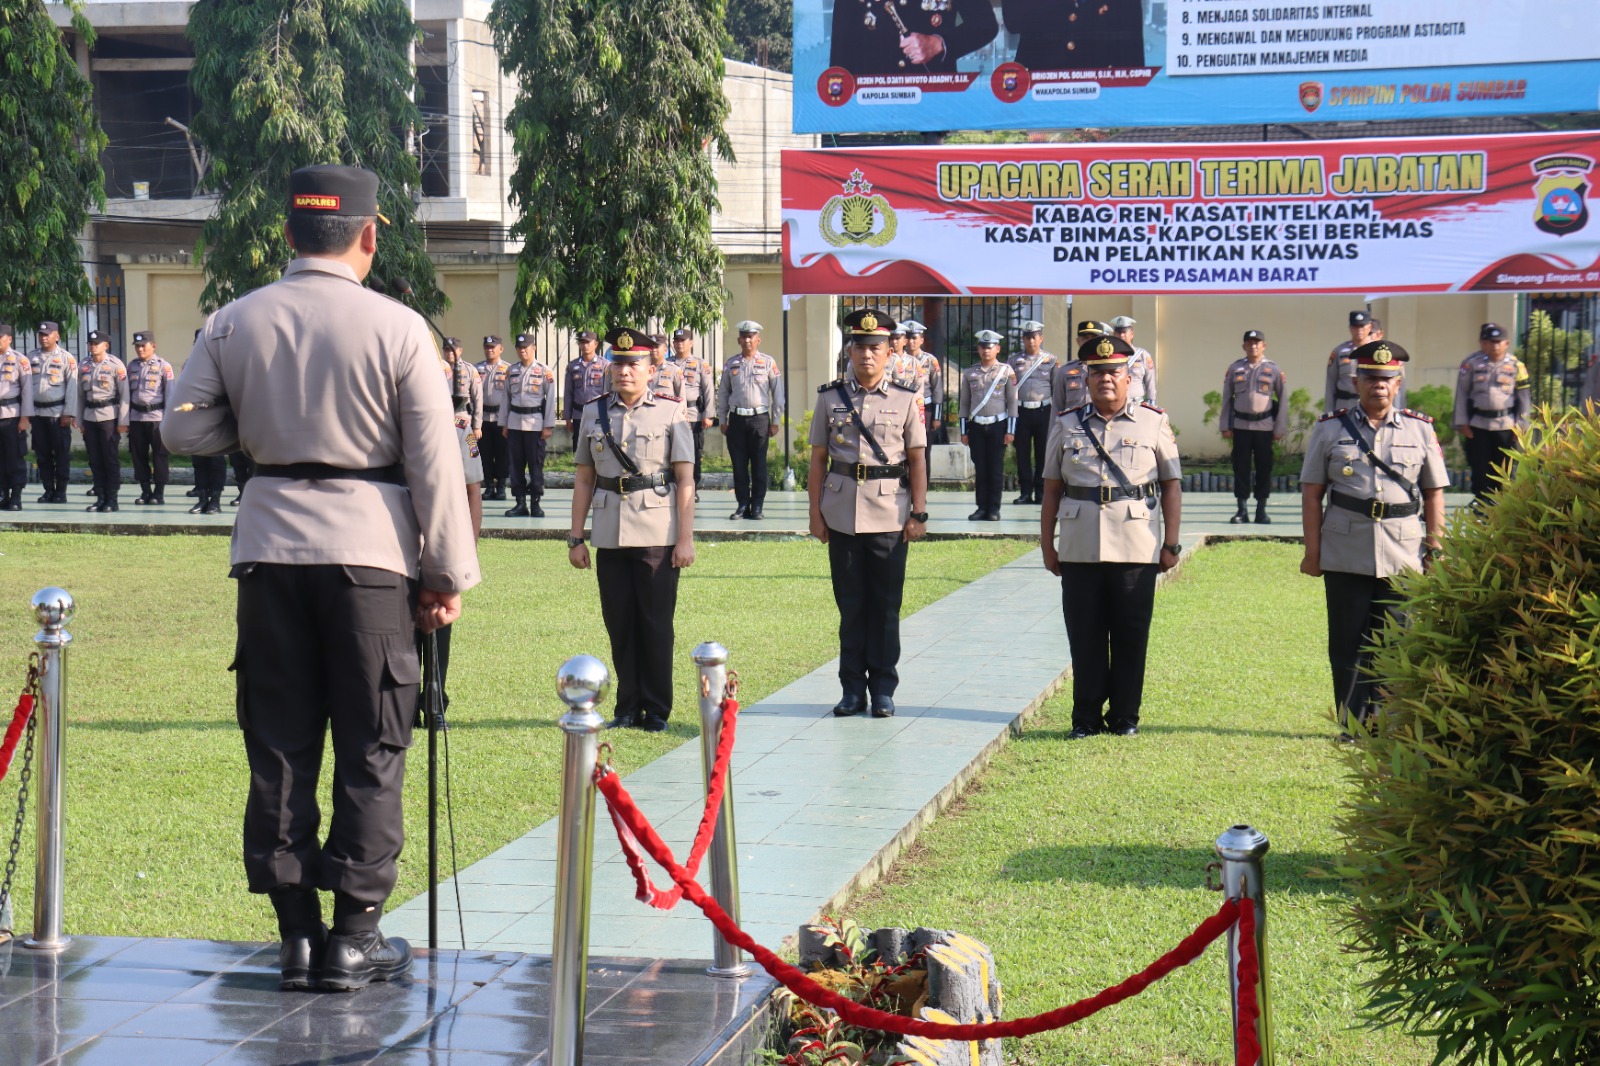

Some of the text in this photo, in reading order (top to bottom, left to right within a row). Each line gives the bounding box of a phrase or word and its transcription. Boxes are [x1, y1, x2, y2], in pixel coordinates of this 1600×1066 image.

[1182, 4, 1373, 24] 8. MENJAGA SOLIDARITAS INTERNAL
[1182, 21, 1466, 46] 9. MENGAWAL DAN MENDUKUNG PROGRAM ASTACITA
[1177, 49, 1368, 68] 10. PENGUATAN MANAJEMEN MEDIA
[891, 91, 916, 99] SUMBAR
[1329, 79, 1528, 106] SPRIPIM POLDA SUMBAR
[939, 153, 1484, 199] UPACARA SERAH TERIMA JABATAN
[296, 198, 336, 207] KAPOLRES
[1036, 203, 1378, 226] KABAG REN, KASAT INTELKAM,
[985, 222, 1434, 245] KASAT BINMAS, KAPOLSEK SEI BEREMAS
[1053, 243, 1359, 262] DAN PELANTIKAN KASIWAS
[1090, 267, 1319, 283] POLRES PASAMAN BARAT
[1496, 273, 1544, 285] Simpang
[1545, 272, 1584, 284] Empat,
